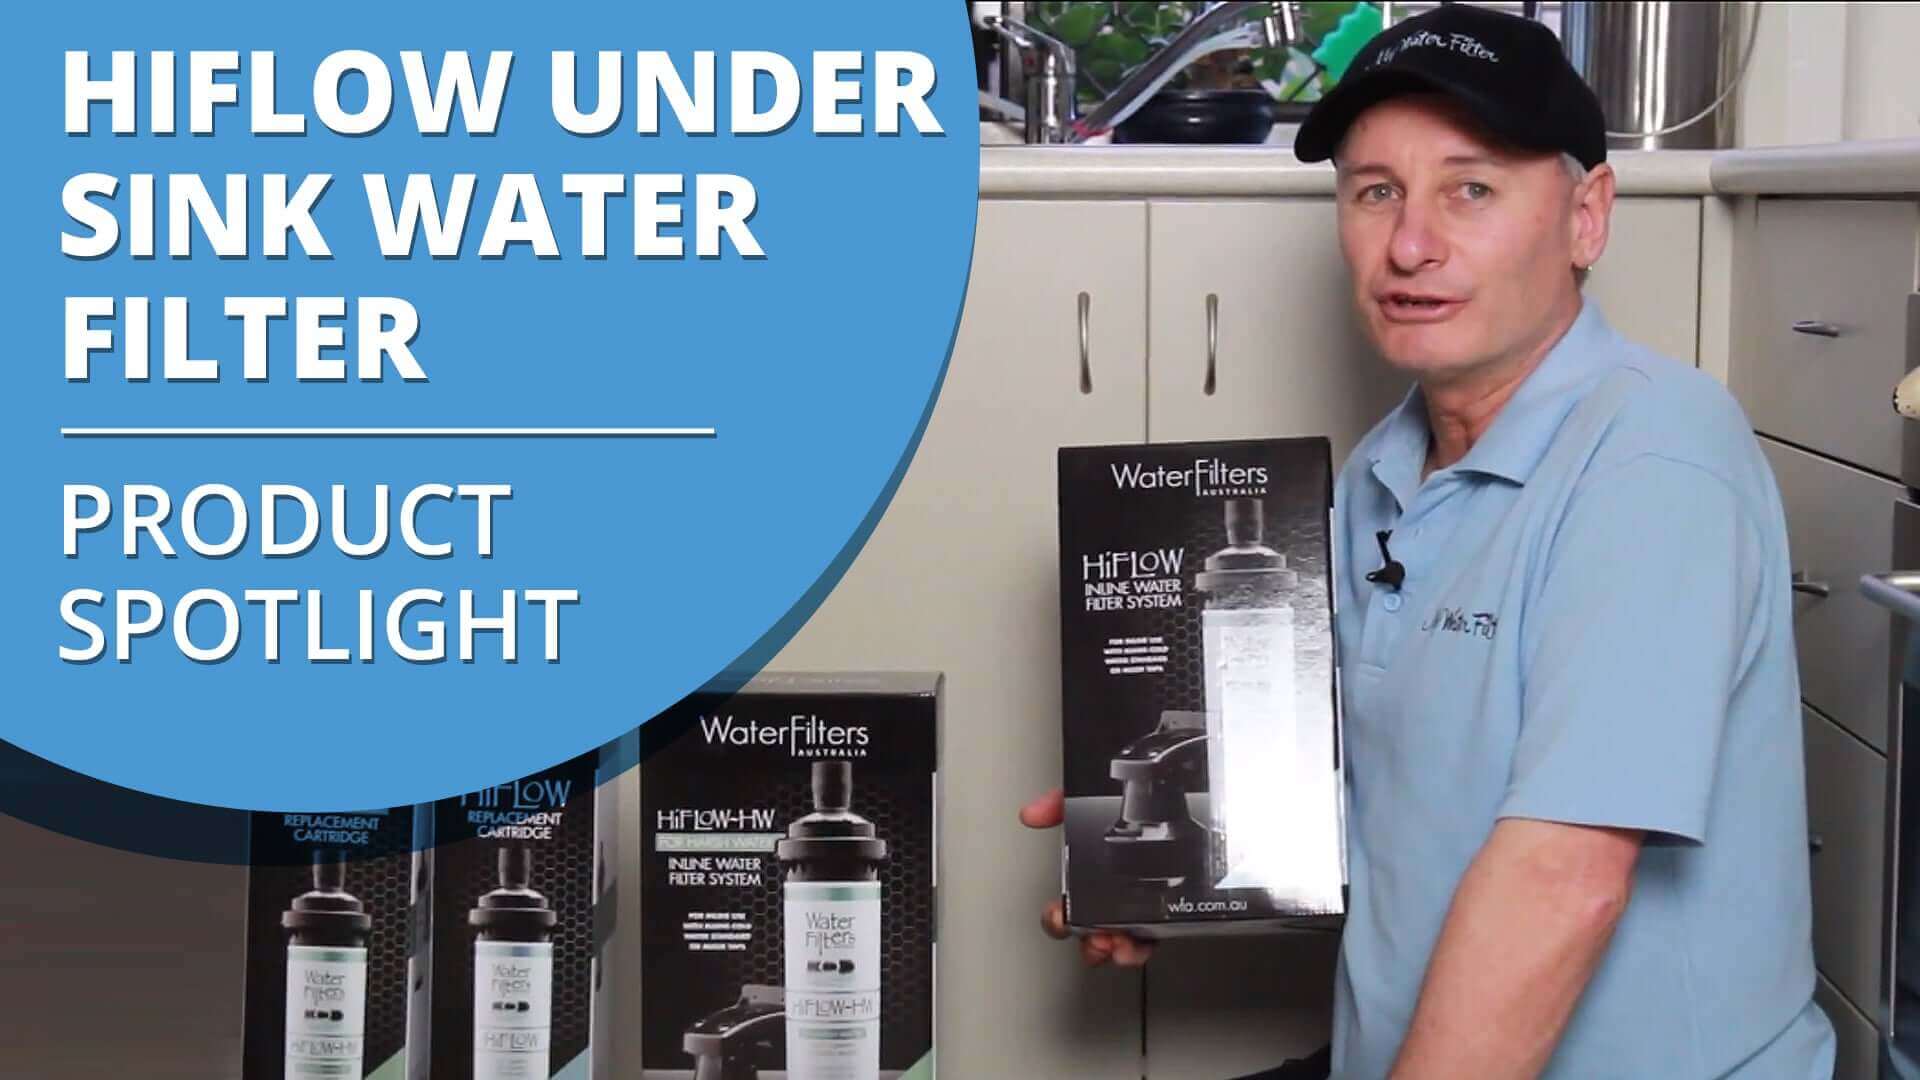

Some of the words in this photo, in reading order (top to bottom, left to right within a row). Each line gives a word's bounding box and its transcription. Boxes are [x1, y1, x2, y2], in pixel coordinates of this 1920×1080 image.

[1202, 487, 1267, 496] AUSTRALIA
[1084, 581, 1130, 596] INLINE
[1133, 579, 1182, 594] WATER
[1086, 596, 1124, 611] FILTER
[1127, 594, 1182, 609] SYSTEM
[798, 748, 867, 757] AUSTRALIA
[284, 814, 380, 830] REPLACEMENT
[467, 810, 563, 825] REPLACEMENT
[293, 829, 369, 845] CARTRIDGE
[477, 825, 553, 840] CARTRIDGE
[668, 857, 713, 871] INLINE
[715, 857, 762, 871] WATER
[669, 872, 706, 886] FILTER
[709, 872, 762, 886] SYSTEM
[805, 911, 856, 930] Water
